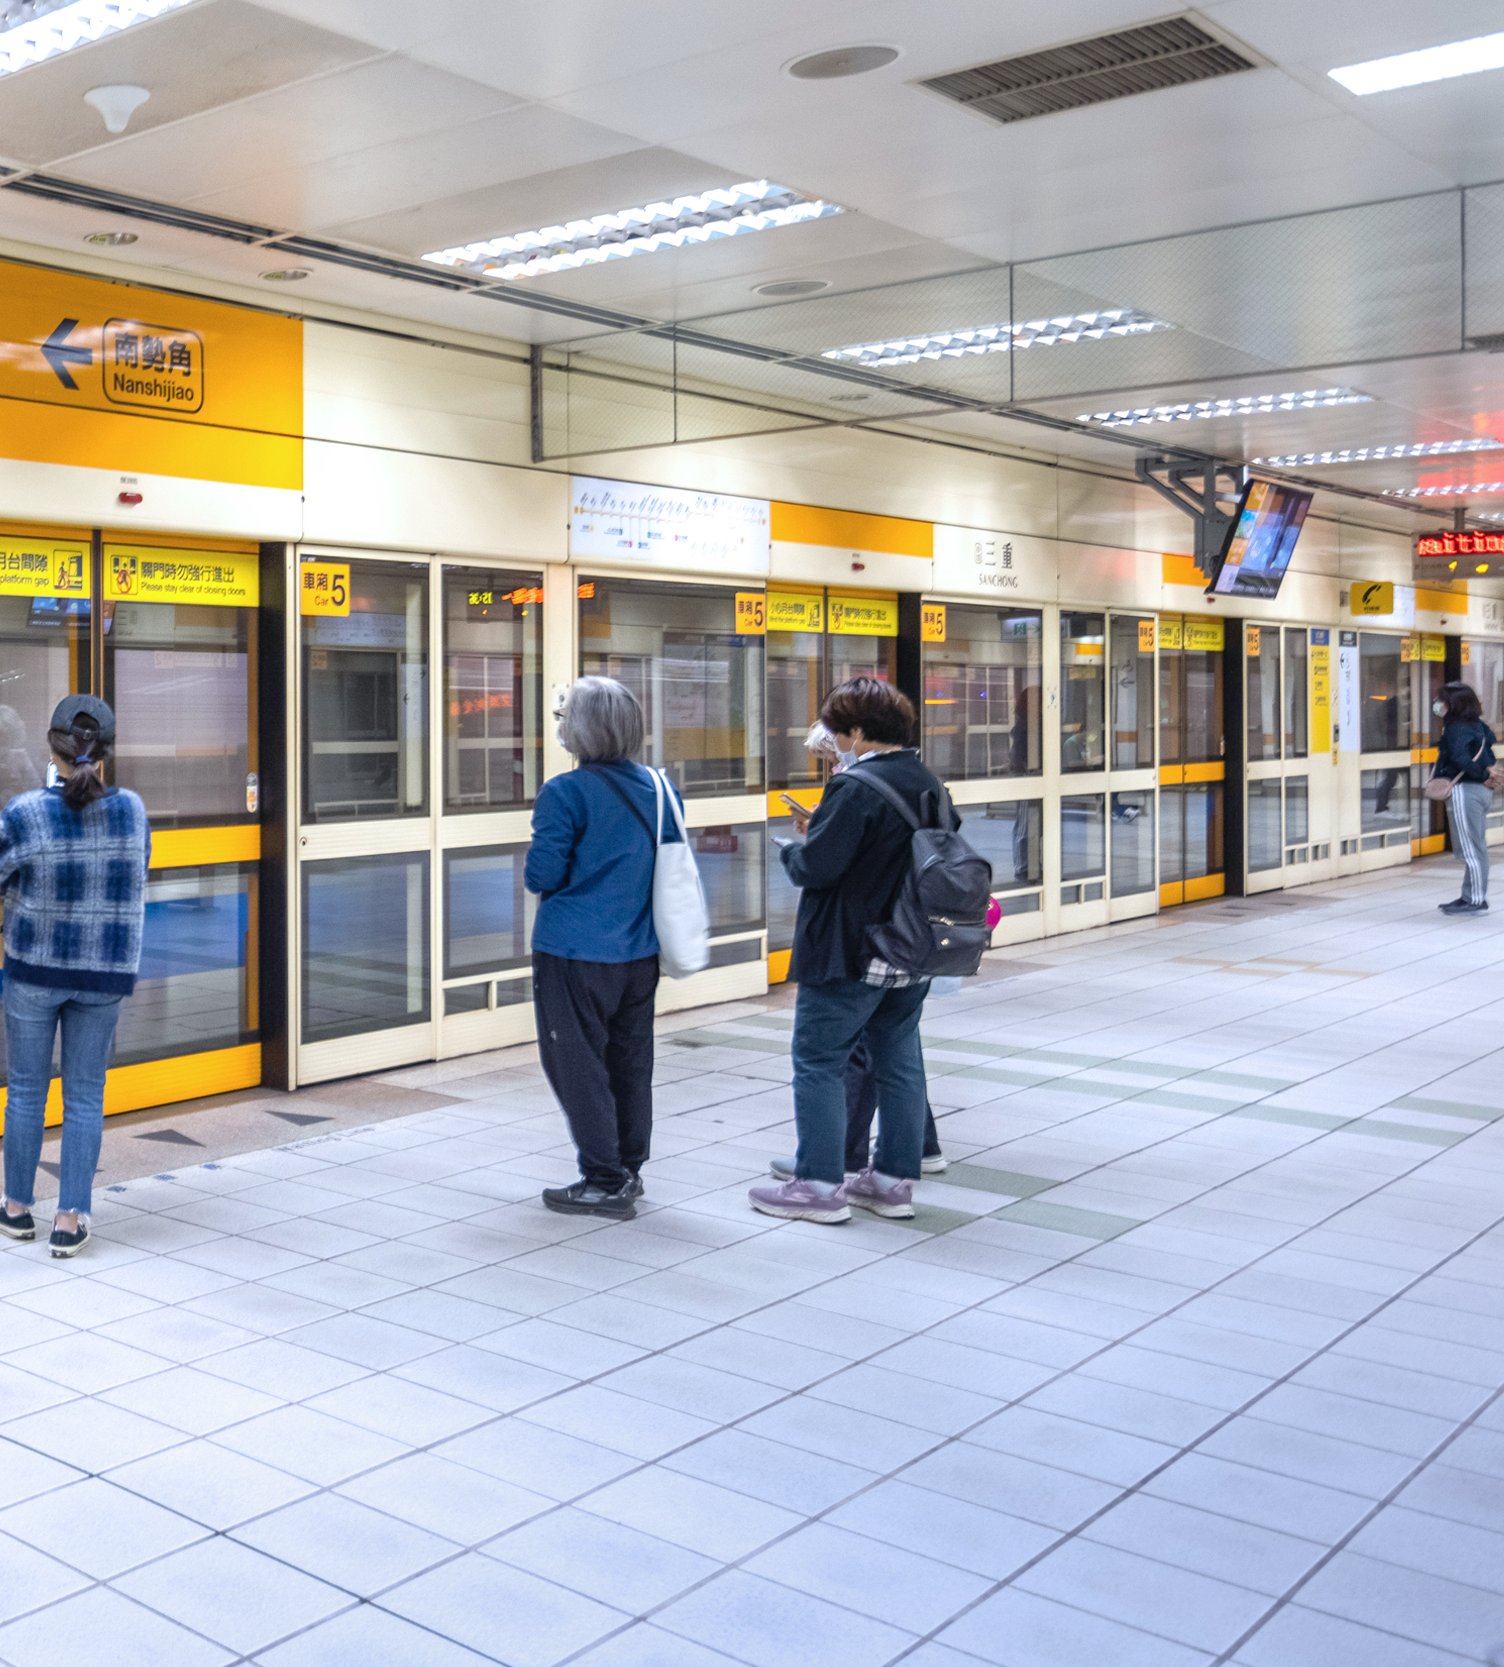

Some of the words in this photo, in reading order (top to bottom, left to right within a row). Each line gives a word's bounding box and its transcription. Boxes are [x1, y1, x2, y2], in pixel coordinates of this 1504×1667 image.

[114, 332, 192, 377] 南勢角
[113, 373, 195, 402] Nanshijiao
[0, 574, 33, 585] platform
[34, 577, 50, 587] gap
[141, 581, 163, 592] Please
[165, 584, 178, 594] stay
[179, 585, 194, 593] clear
[196, 585, 203, 593] of
[204, 586, 227, 596] closing
[227, 587, 246, 595] doors
[303, 572, 329, 591] 車廂
[331, 574, 346, 606] 5
[314, 595, 329, 606] Car
[754, 601, 763, 627] 5
[936, 612, 943, 635] 5
